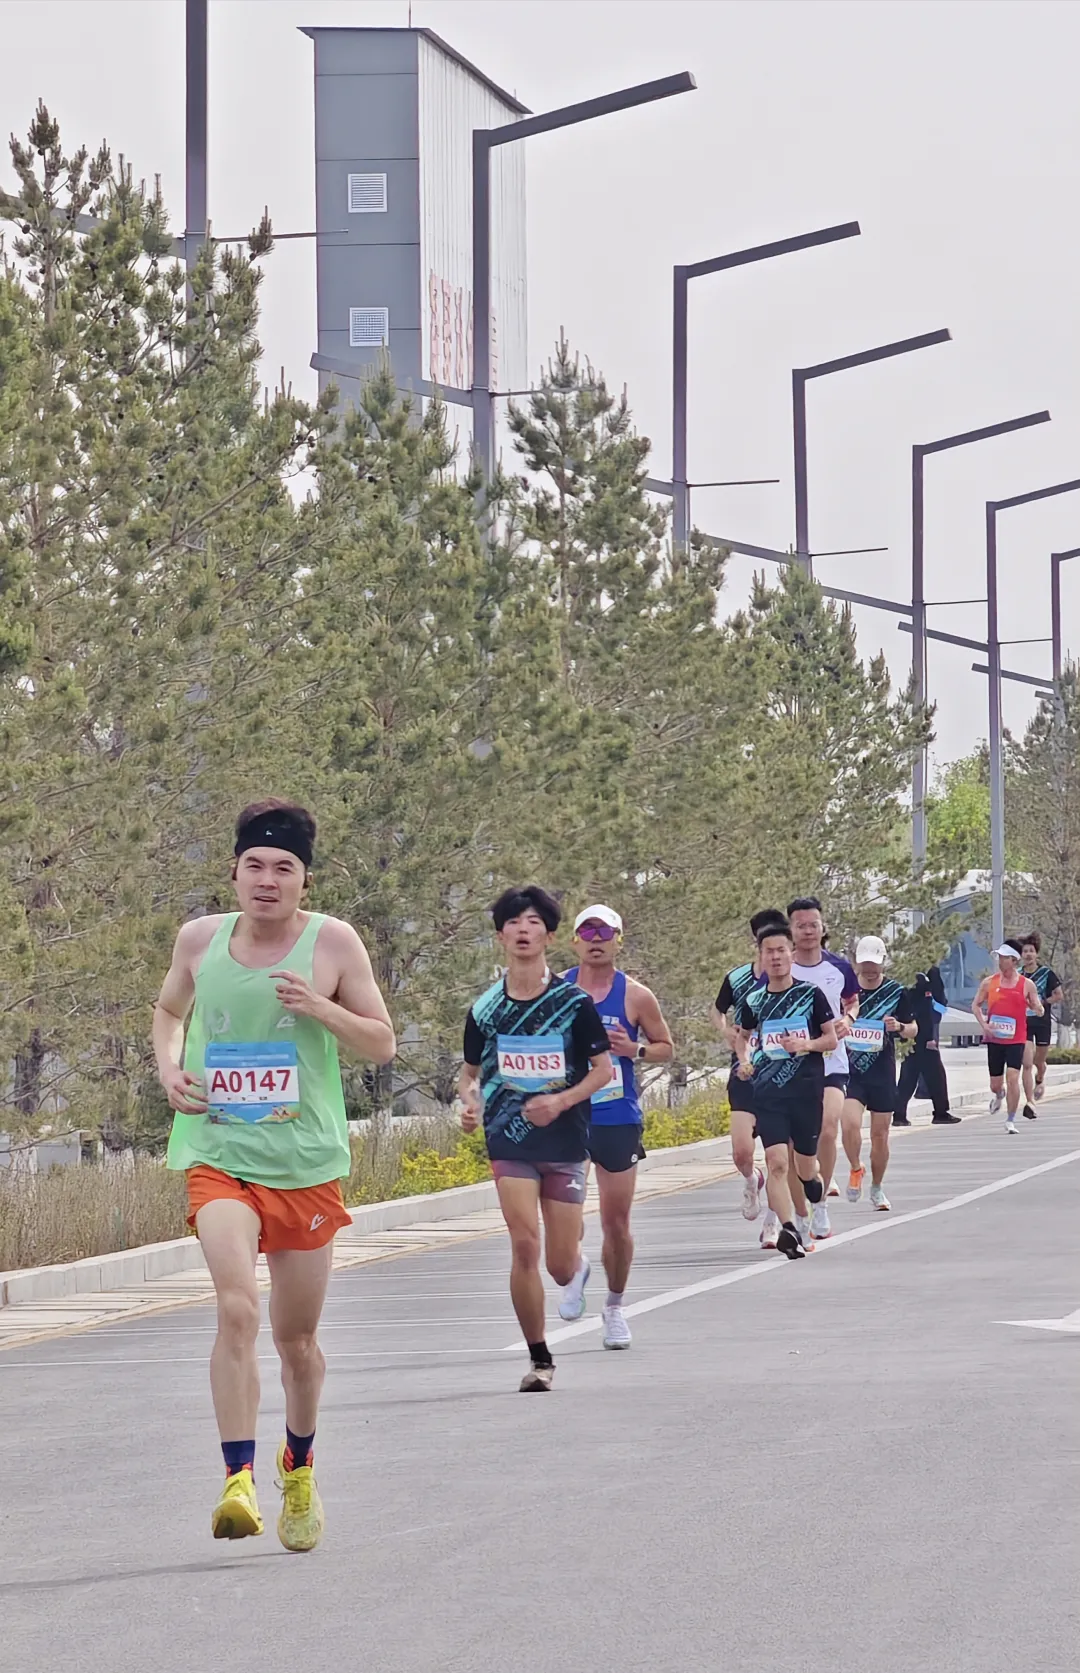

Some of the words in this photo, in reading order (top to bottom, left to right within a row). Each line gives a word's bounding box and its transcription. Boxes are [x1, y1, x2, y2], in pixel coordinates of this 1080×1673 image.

[766, 1029, 806, 1045] A04
[503, 1054, 561, 1071] A0183
[211, 1069, 291, 1093] A0147
